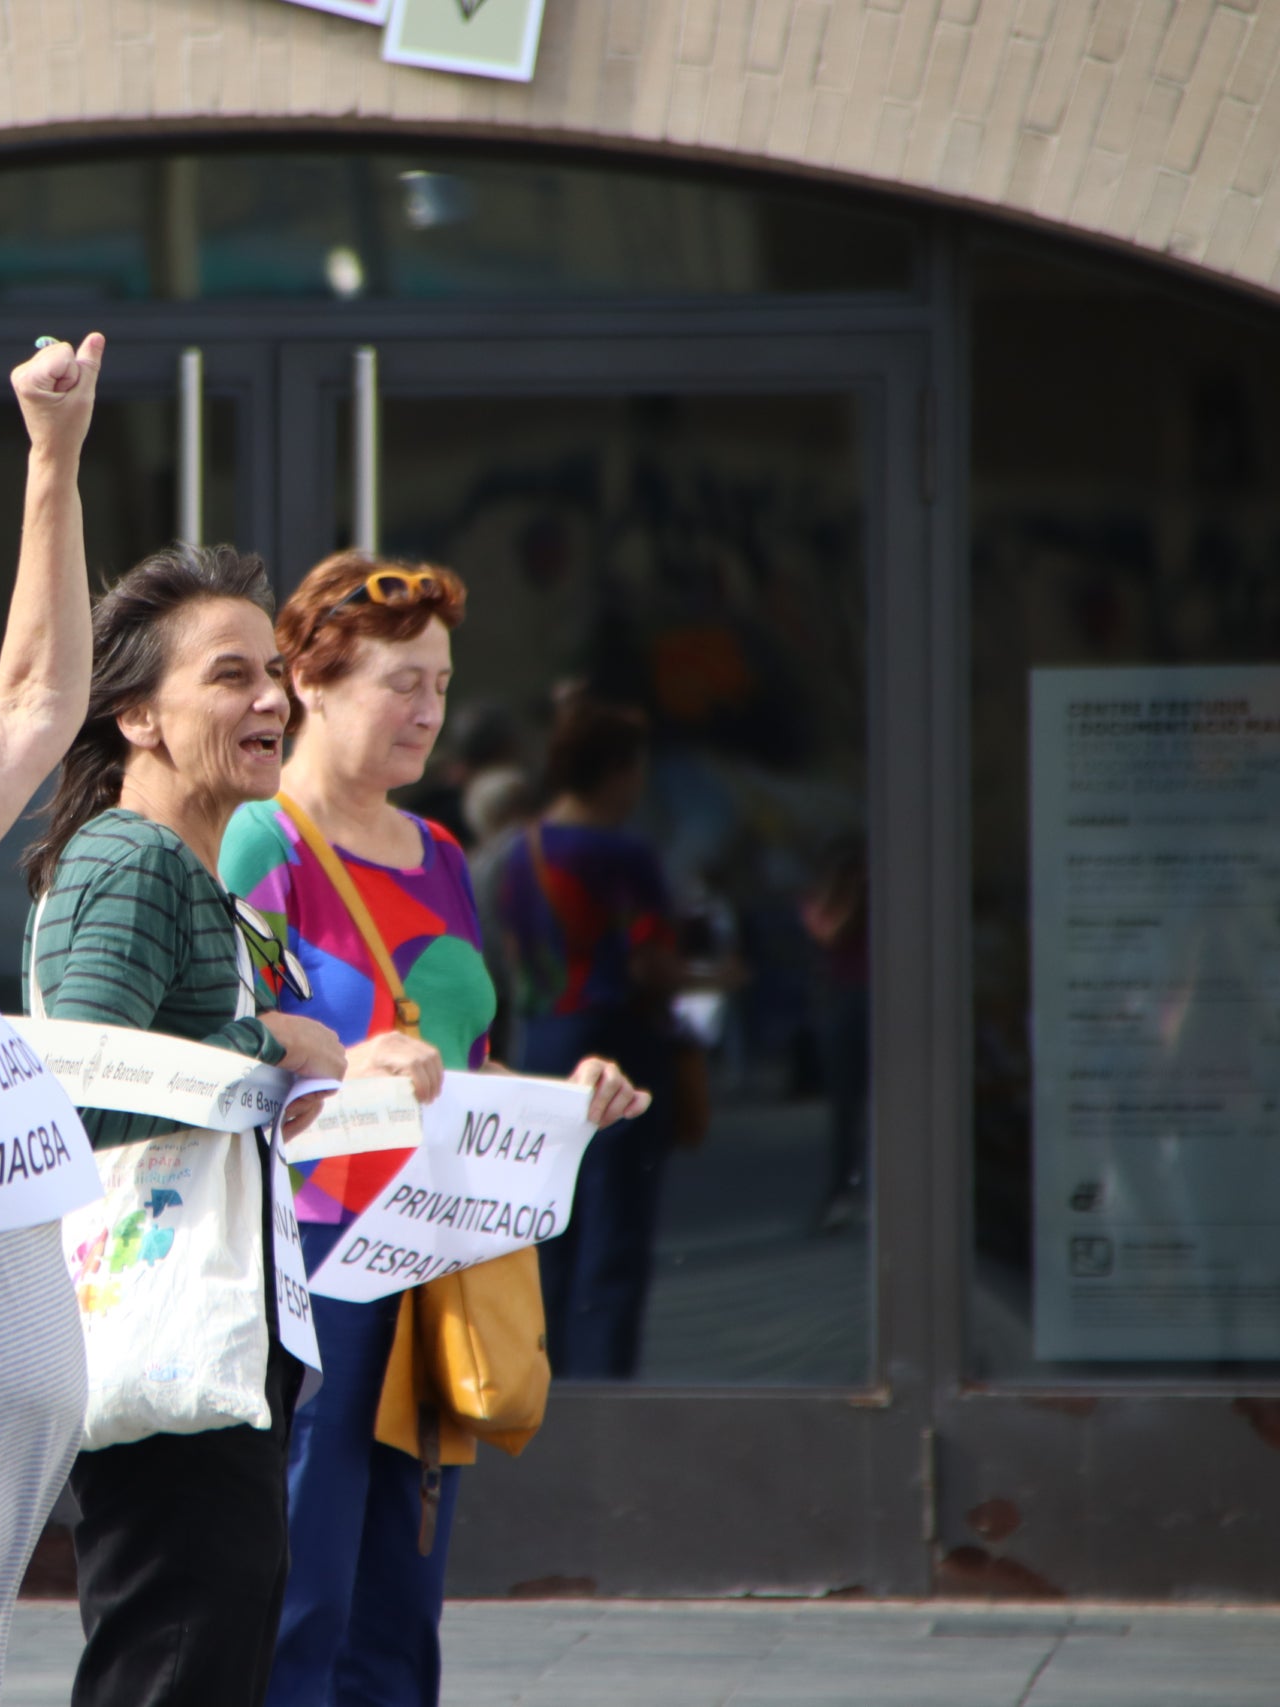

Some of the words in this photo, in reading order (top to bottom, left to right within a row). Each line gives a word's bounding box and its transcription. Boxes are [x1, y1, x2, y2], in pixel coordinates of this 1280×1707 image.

[114, 1061, 155, 1085] Barcelona
[240, 1088, 253, 1109] de
[456, 1110, 501, 1158] NO
[494, 1127, 515, 1160] A
[513, 1130, 547, 1165] LA
[383, 1184, 557, 1242] PRIVATITZACIÓ
[340, 1236, 444, 1282] D'ESPAI
